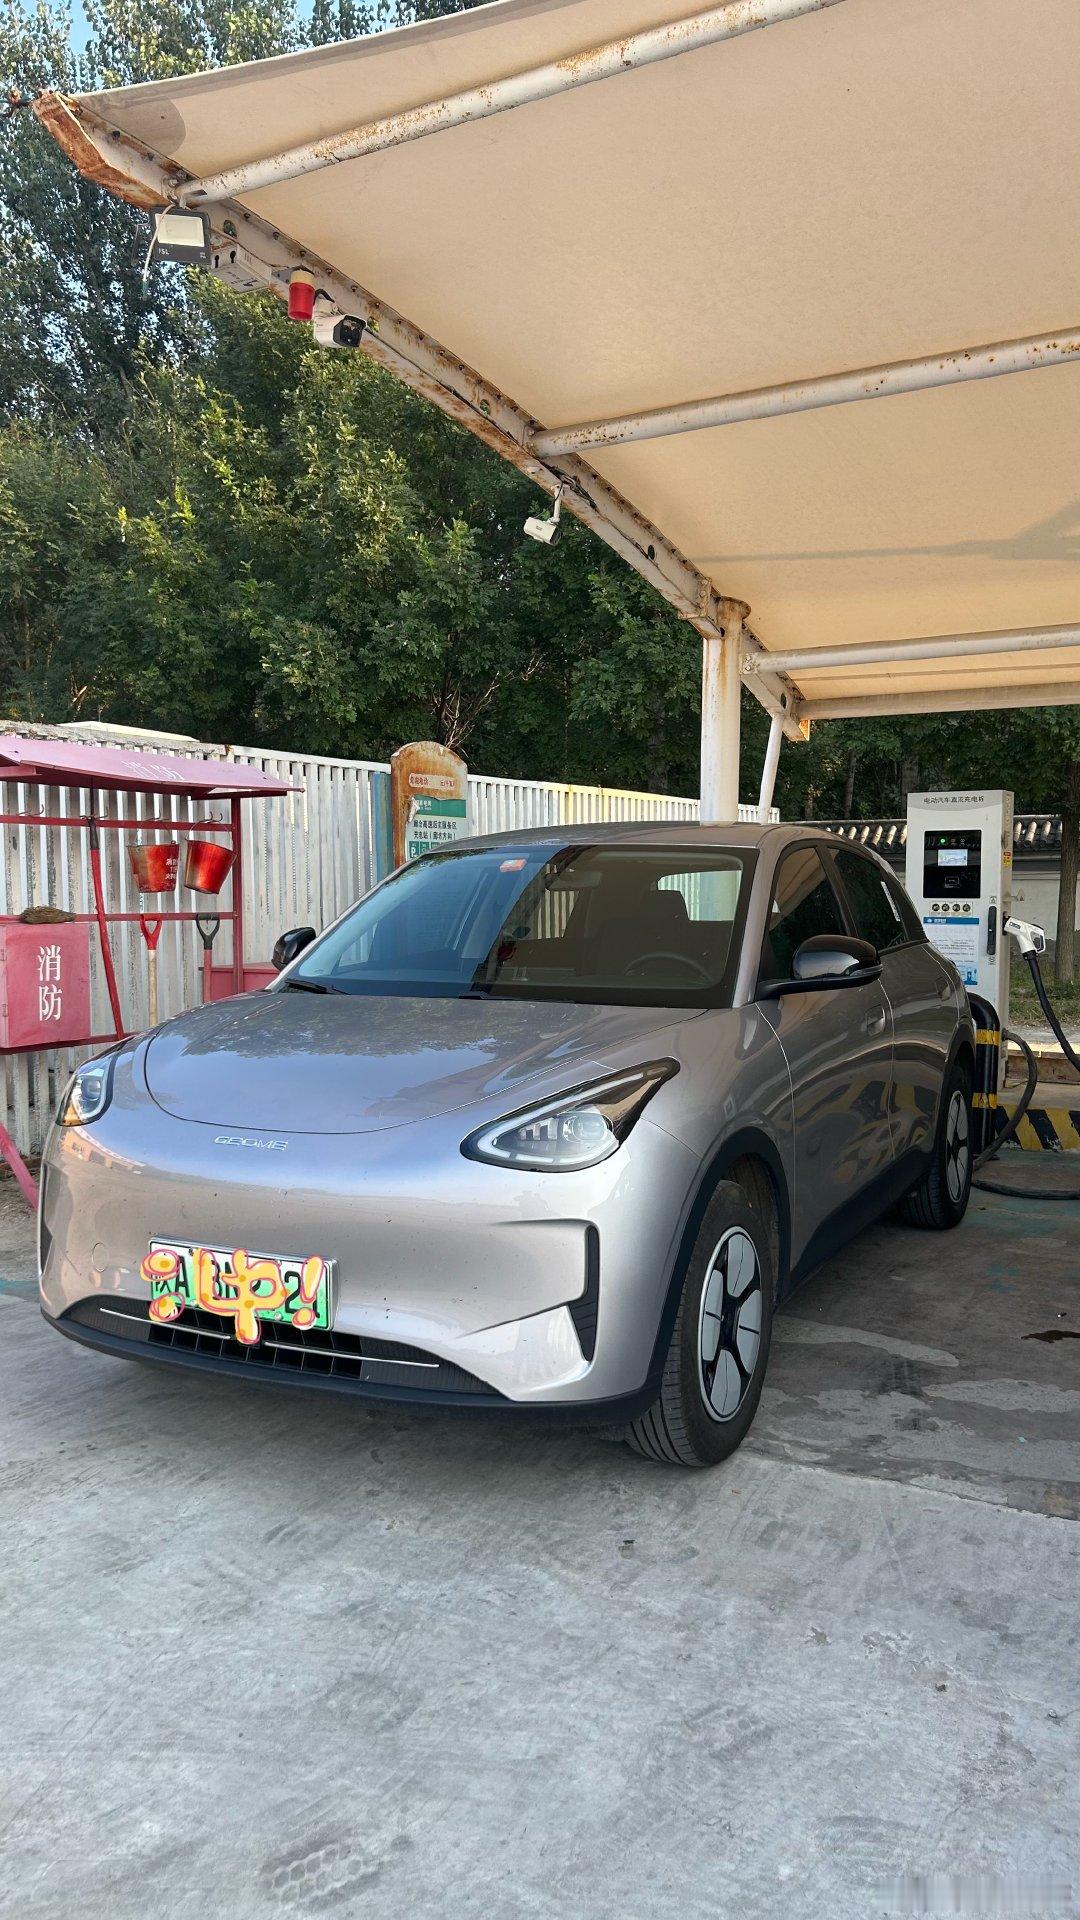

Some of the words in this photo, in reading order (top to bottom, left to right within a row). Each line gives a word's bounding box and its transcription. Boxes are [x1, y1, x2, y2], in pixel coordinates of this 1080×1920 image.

[923, 795, 984, 804] 电动汽车直流充电桩
[36, 945, 63, 1022] 消防
[214, 1135, 289, 1151] GEOME
